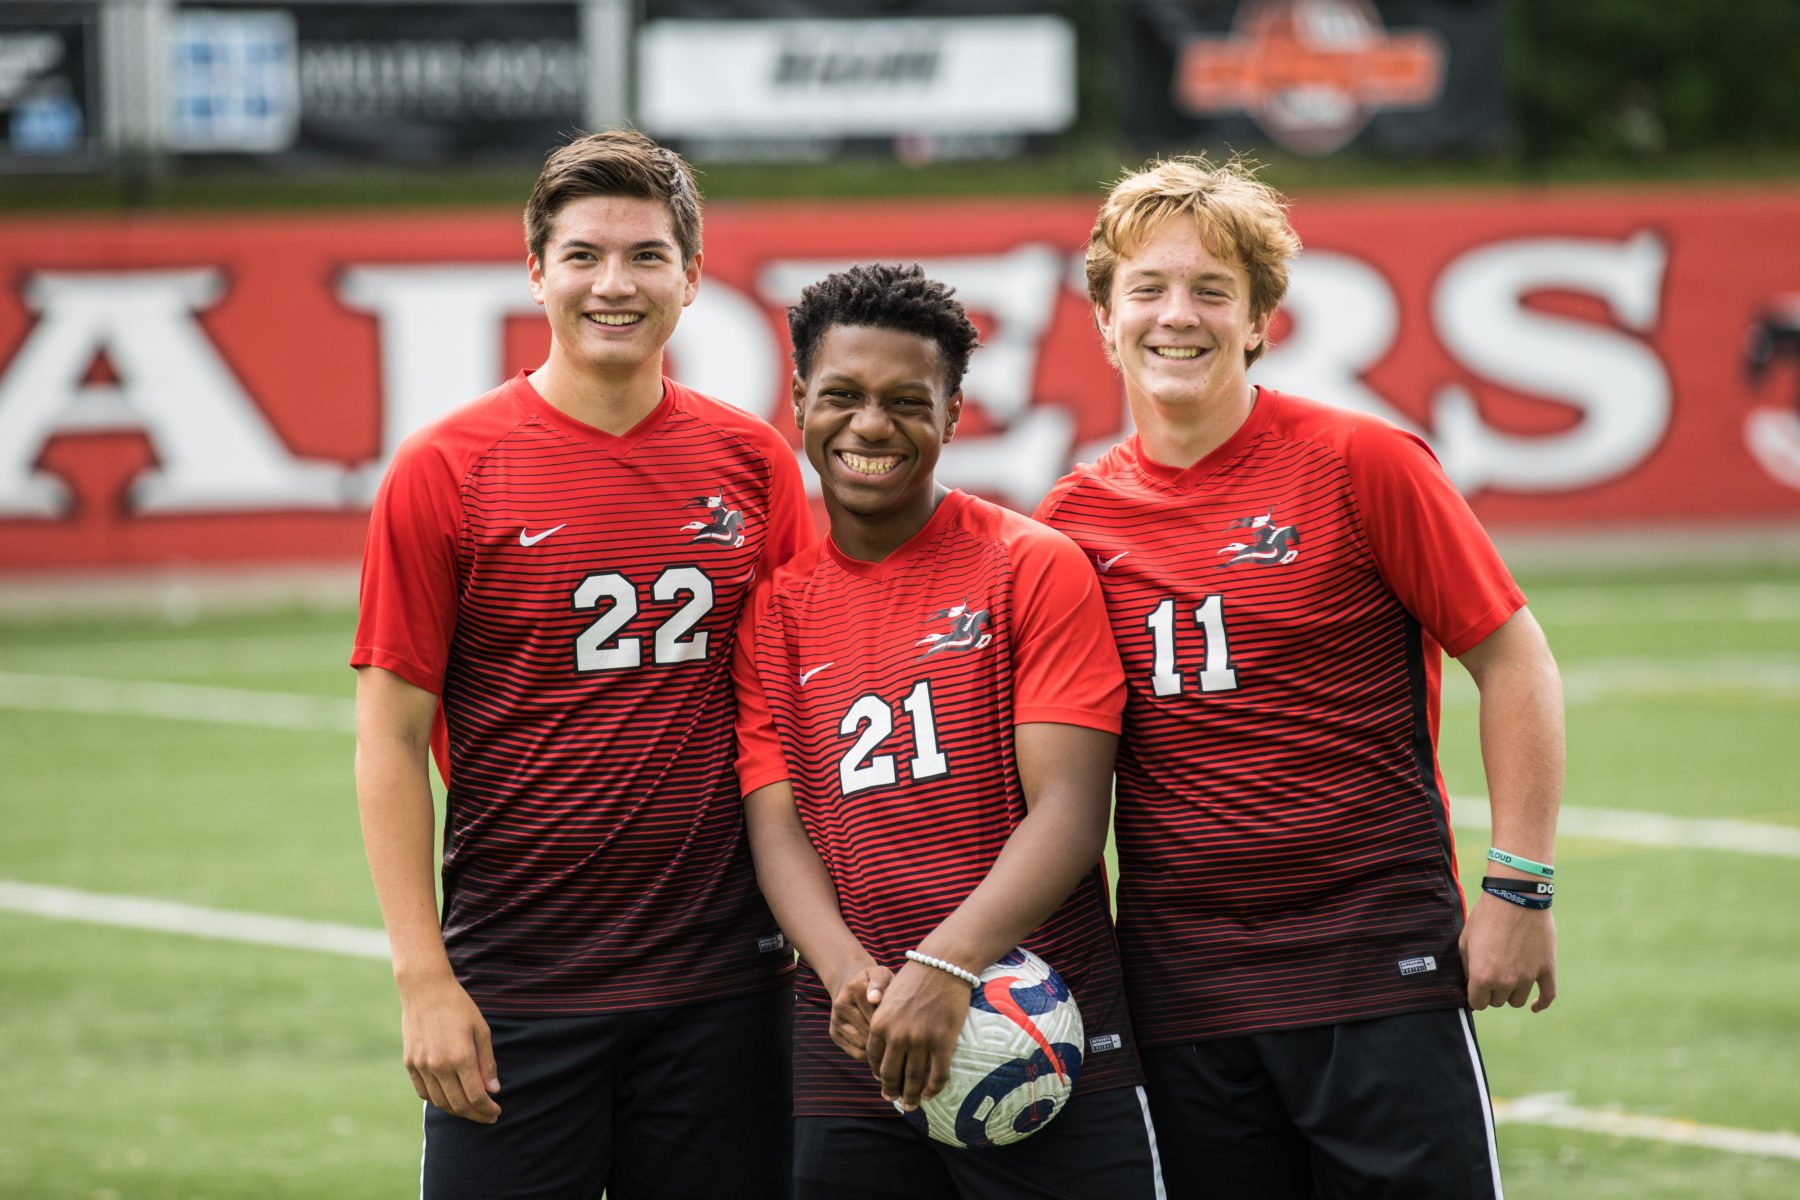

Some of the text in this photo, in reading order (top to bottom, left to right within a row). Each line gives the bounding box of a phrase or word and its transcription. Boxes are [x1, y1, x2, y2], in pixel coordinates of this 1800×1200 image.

[571, 564, 715, 675] 22
[1146, 594, 1239, 698] 11
[838, 677, 951, 800] 21
[1488, 888, 1527, 905] ACROSSE
